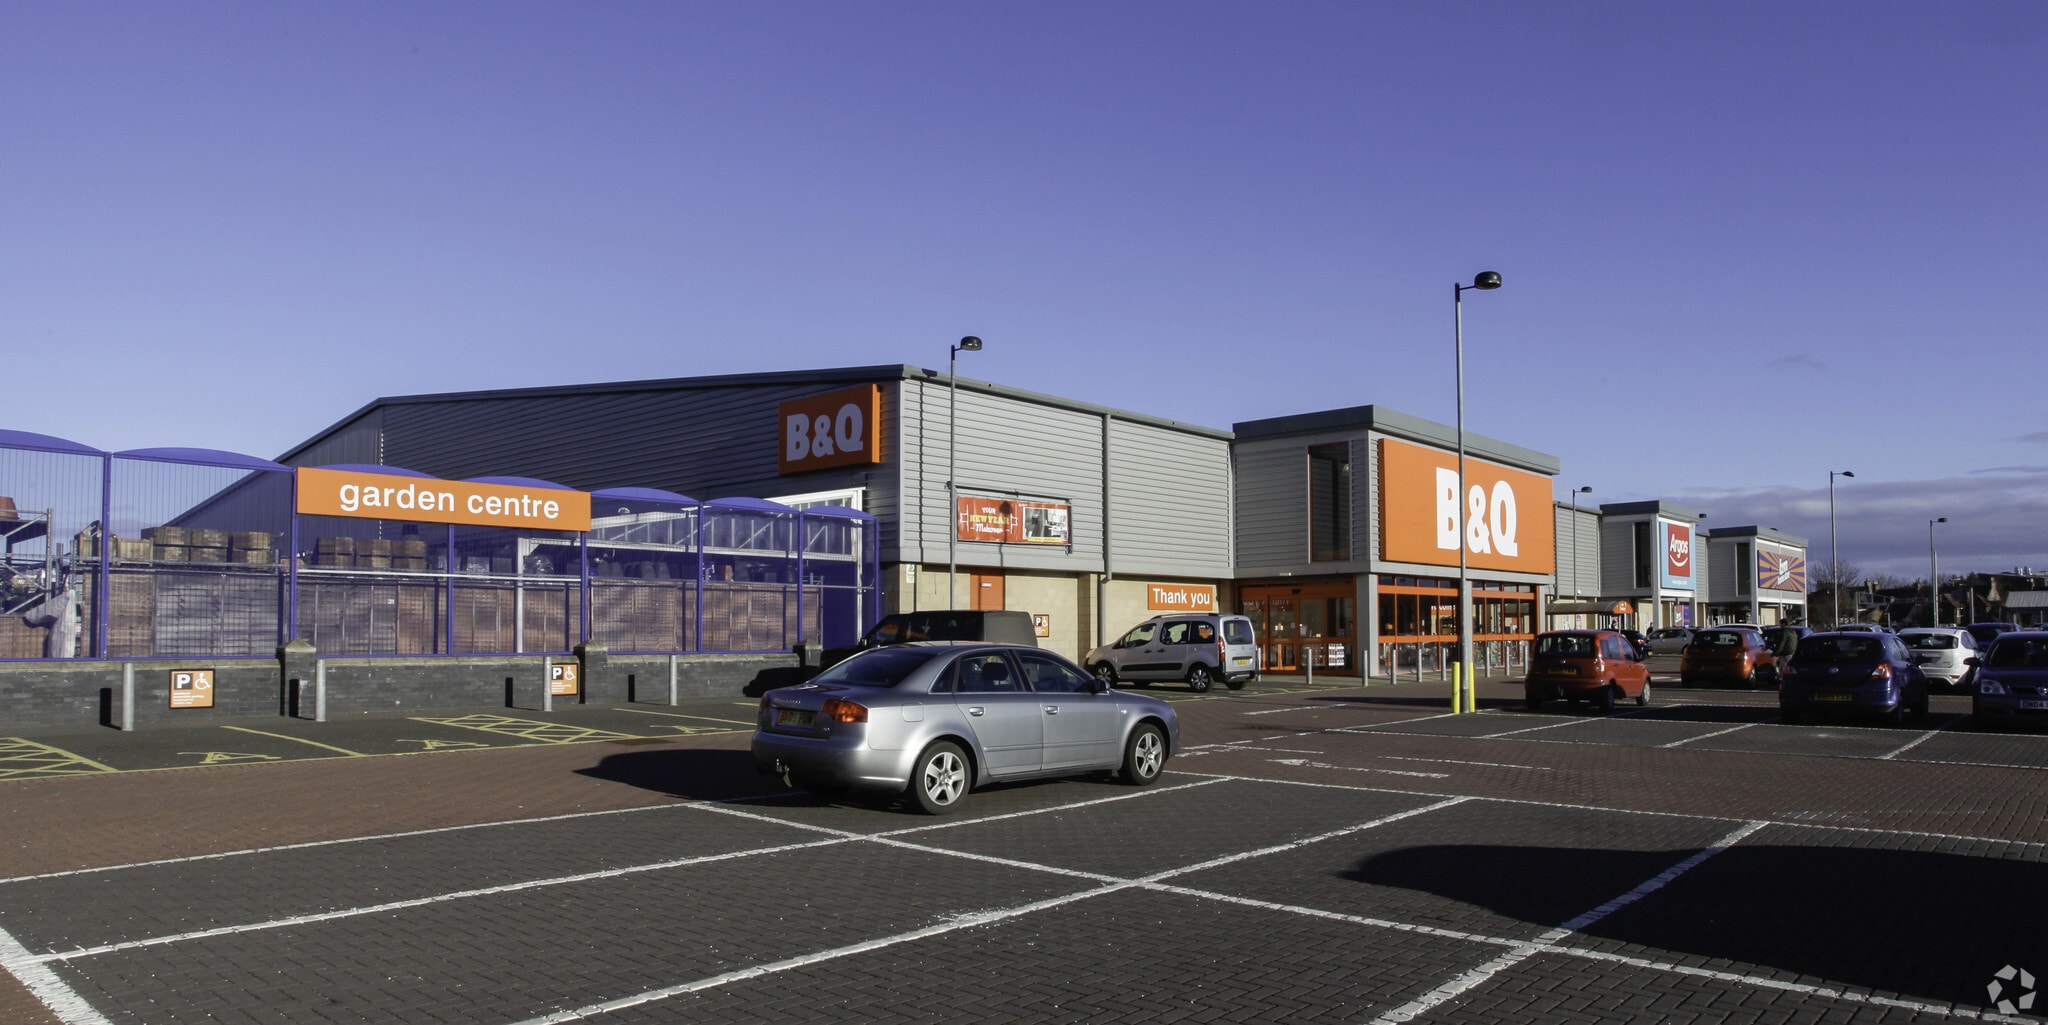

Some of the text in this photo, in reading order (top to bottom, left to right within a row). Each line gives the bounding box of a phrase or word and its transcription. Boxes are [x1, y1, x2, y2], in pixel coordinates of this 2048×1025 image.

[786, 403, 864, 462] B&Q
[339, 483, 560, 519] garden centre
[981, 507, 996, 515] YOUR
[969, 514, 986, 523] NEW
[1436, 467, 1518, 557] B&Q
[1669, 533, 1689, 559] Argos
[1152, 587, 1210, 608] Thank you
[176, 674, 191, 689] P
[552, 667, 563, 680] P
